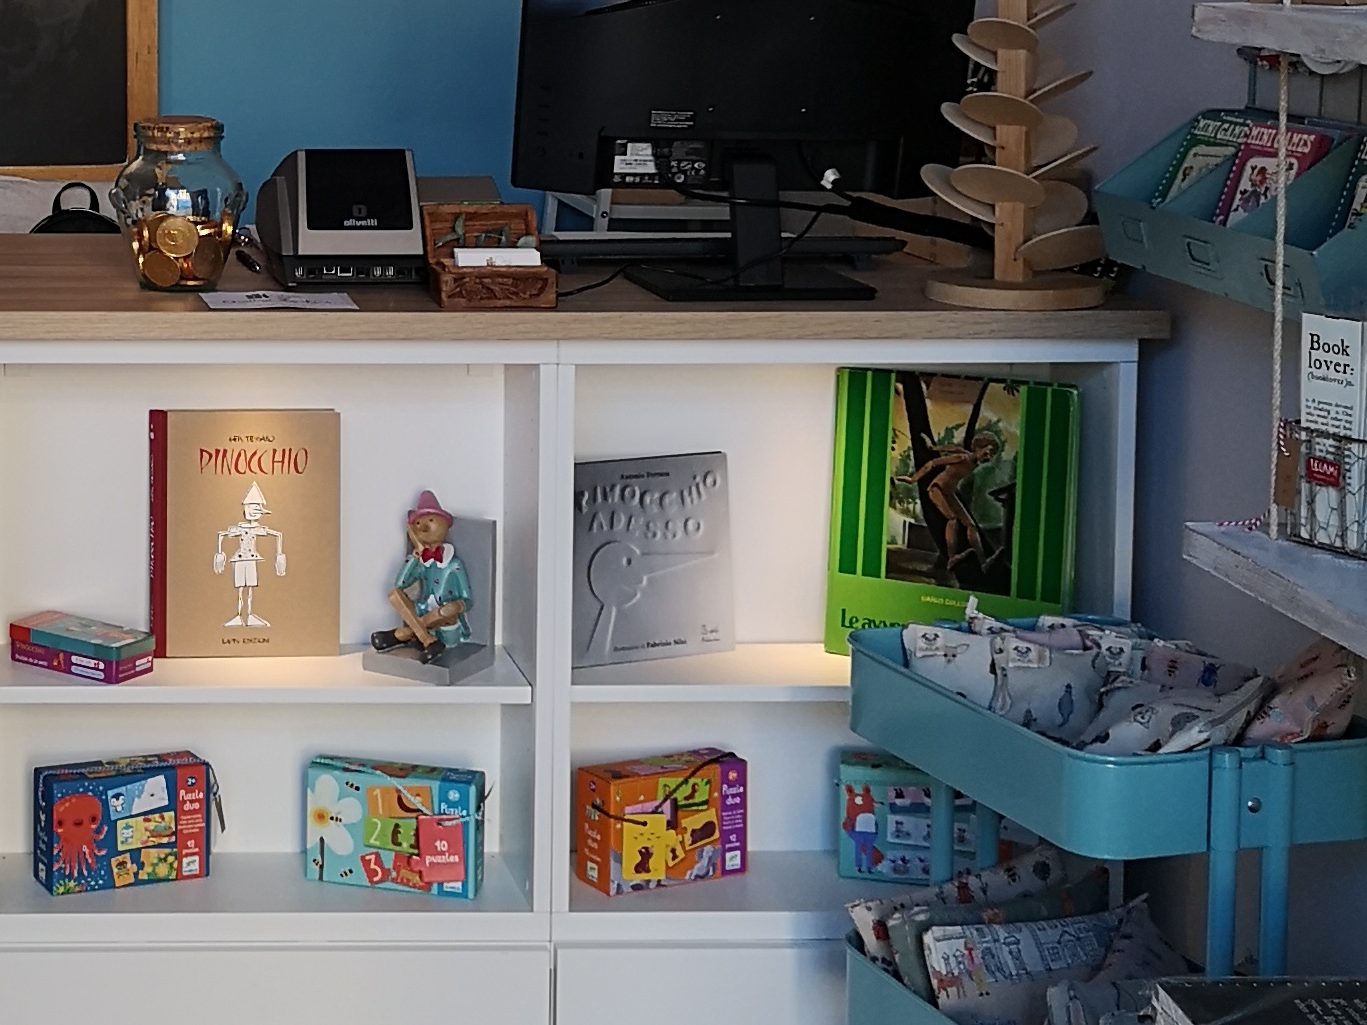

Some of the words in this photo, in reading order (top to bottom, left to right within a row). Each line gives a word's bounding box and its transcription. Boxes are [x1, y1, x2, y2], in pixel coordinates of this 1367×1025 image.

[1194, 118, 1218, 137] MINI
[1247, 125, 1277, 148] MINI
[343, 218, 377, 226] olivetti
[1309, 332, 1350, 357] Book
[1308, 350, 1355, 376] lover:
[199, 448, 308, 475] PINOCCHIO
[179, 789, 204, 801] Puzzle
[722, 783, 744, 795] Puzzle
[183, 800, 200, 811] duo
[373, 788, 382, 815] 1
[725, 795, 741, 805] duo
[440, 802, 467, 815] Puzzle
[369, 818, 382, 845] 2
[435, 839, 448, 851] 10
[425, 853, 460, 866] puzzles
[364, 854, 382, 882] 3
